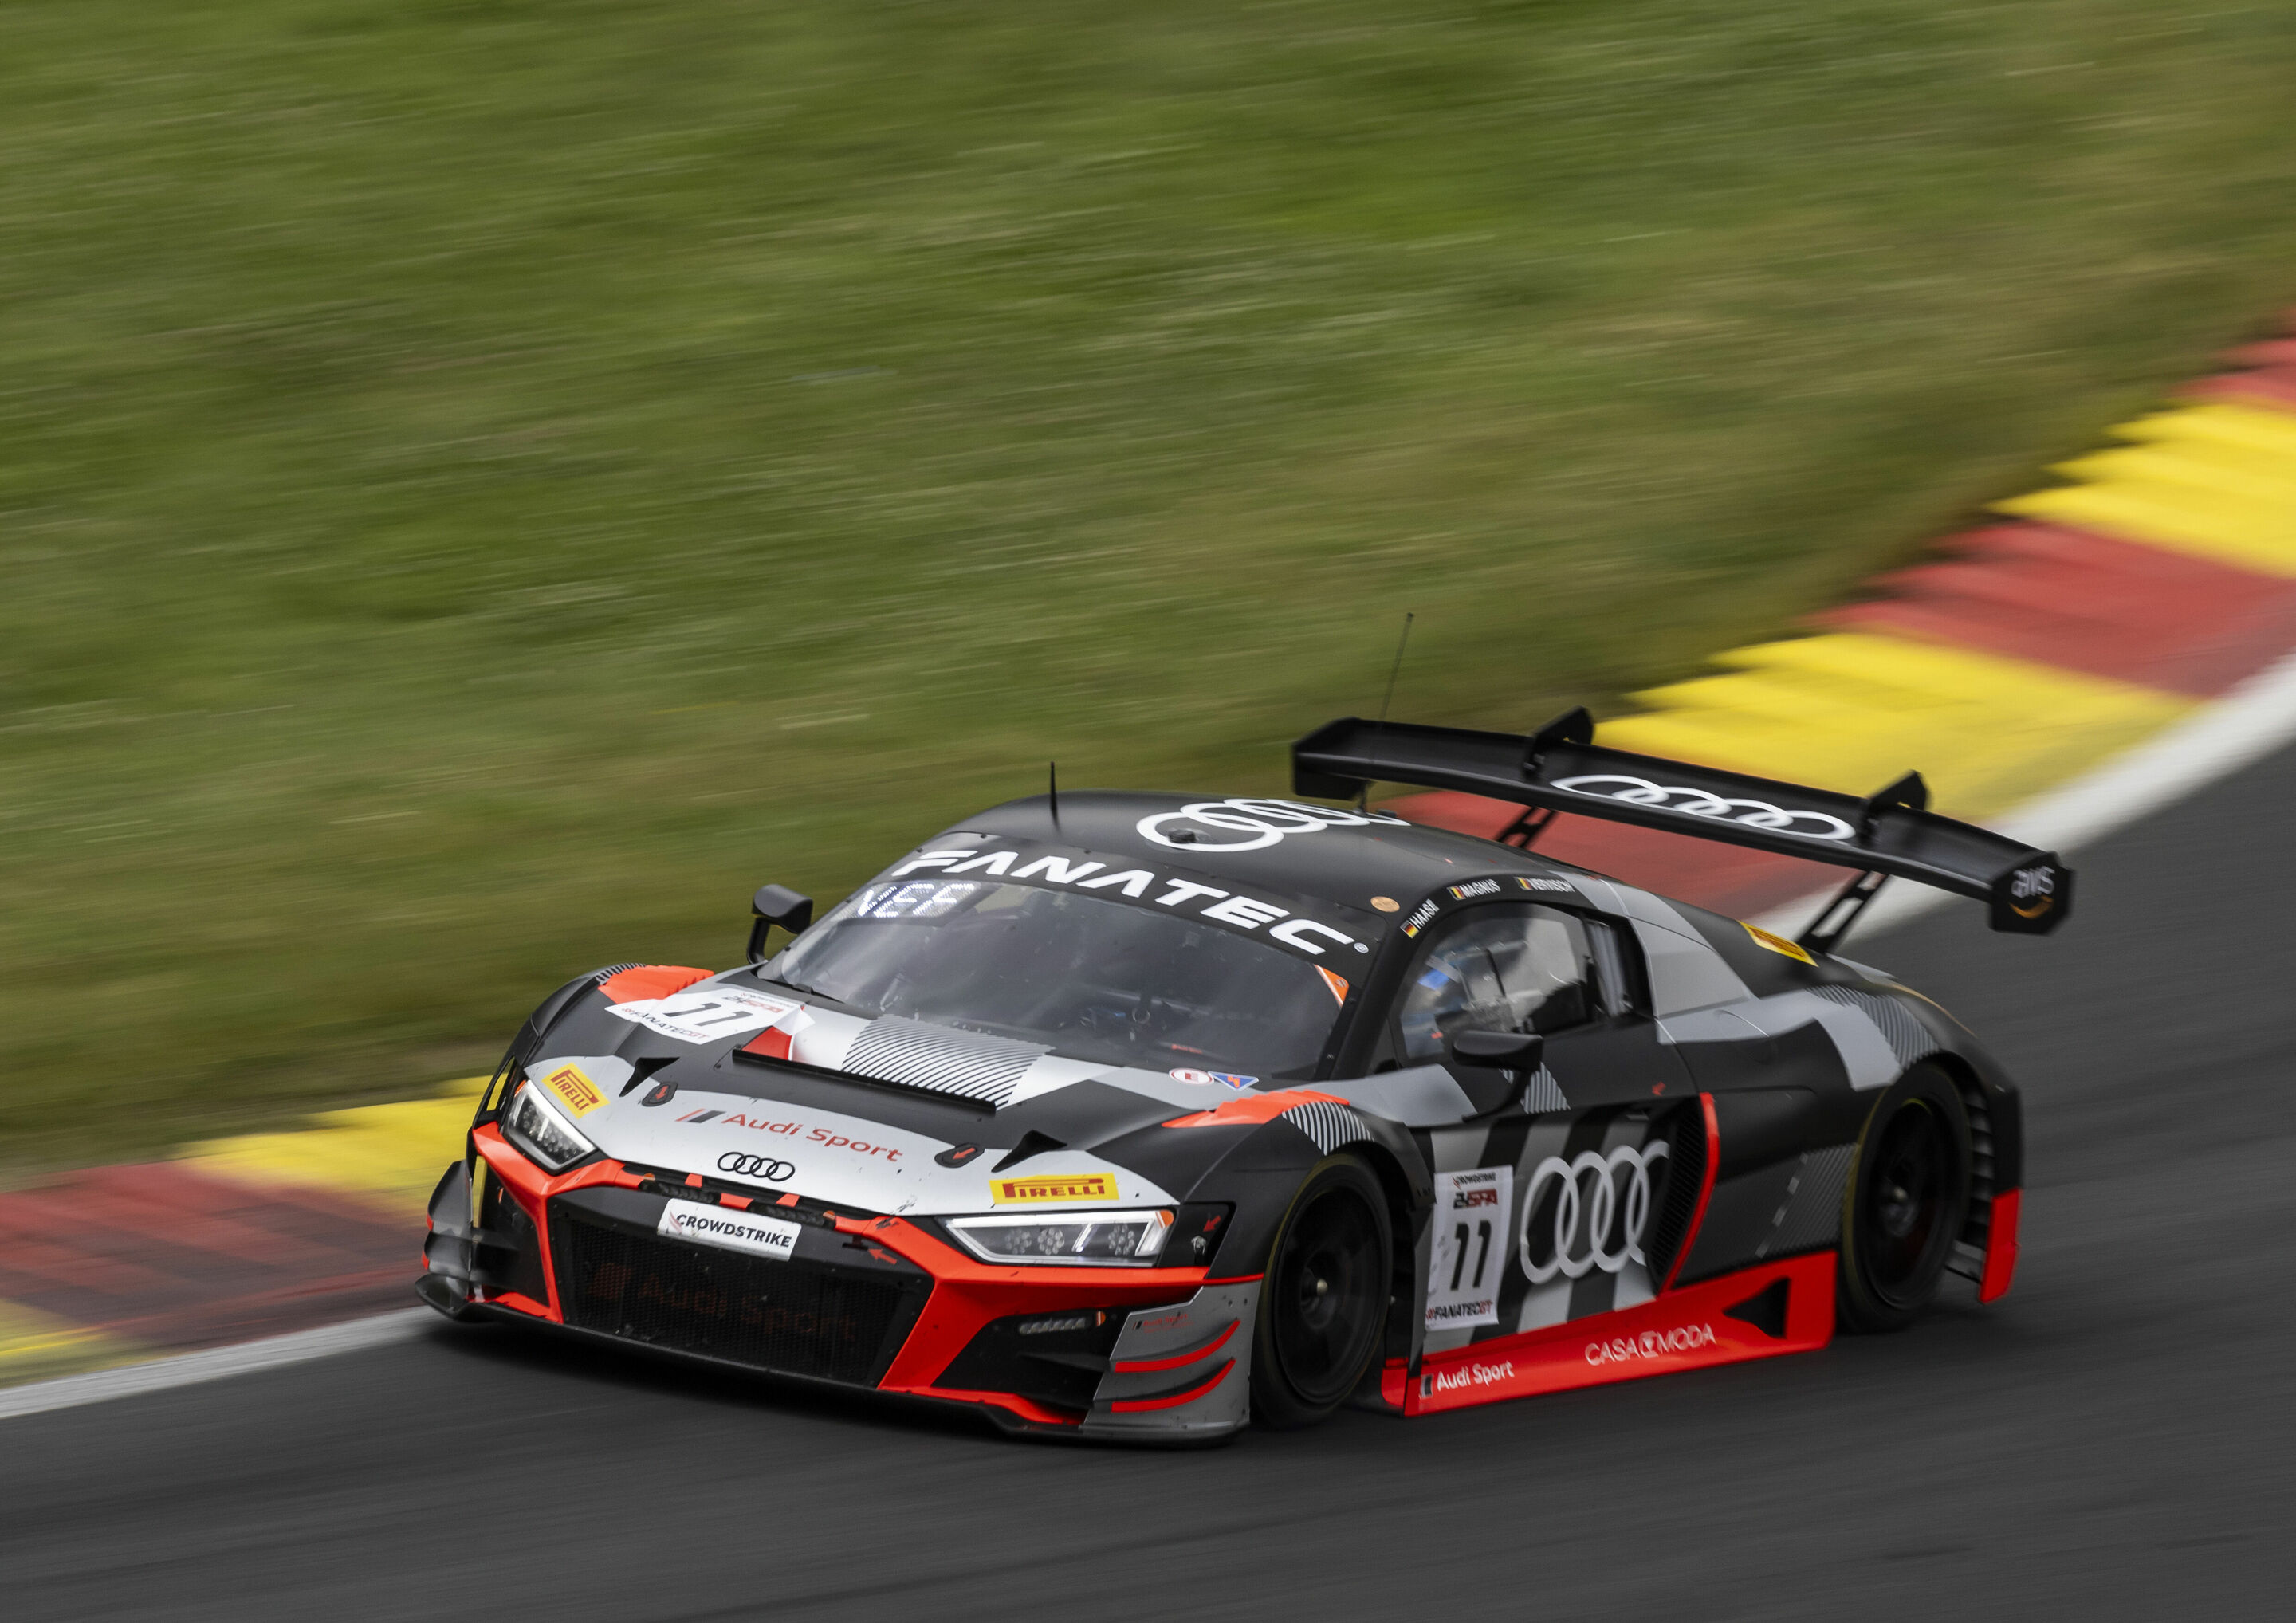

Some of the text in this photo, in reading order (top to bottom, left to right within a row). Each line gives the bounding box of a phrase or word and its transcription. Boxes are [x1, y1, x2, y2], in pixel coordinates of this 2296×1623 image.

[891, 850, 1355, 955] FANATEC
[1458, 878, 1502, 898] MAGNUS
[1409, 898, 1440, 929] HAASE
[663, 1002, 753, 1028] 11
[550, 1069, 600, 1110] PIRELLI
[721, 1114, 903, 1162] Audi Sport
[1002, 1178, 1105, 1198] PIRELLI
[676, 1214, 792, 1248] CROWDSTRIKE
[1450, 1220, 1492, 1291] 11
[1437, 1360, 1515, 1392] Audi Sport
